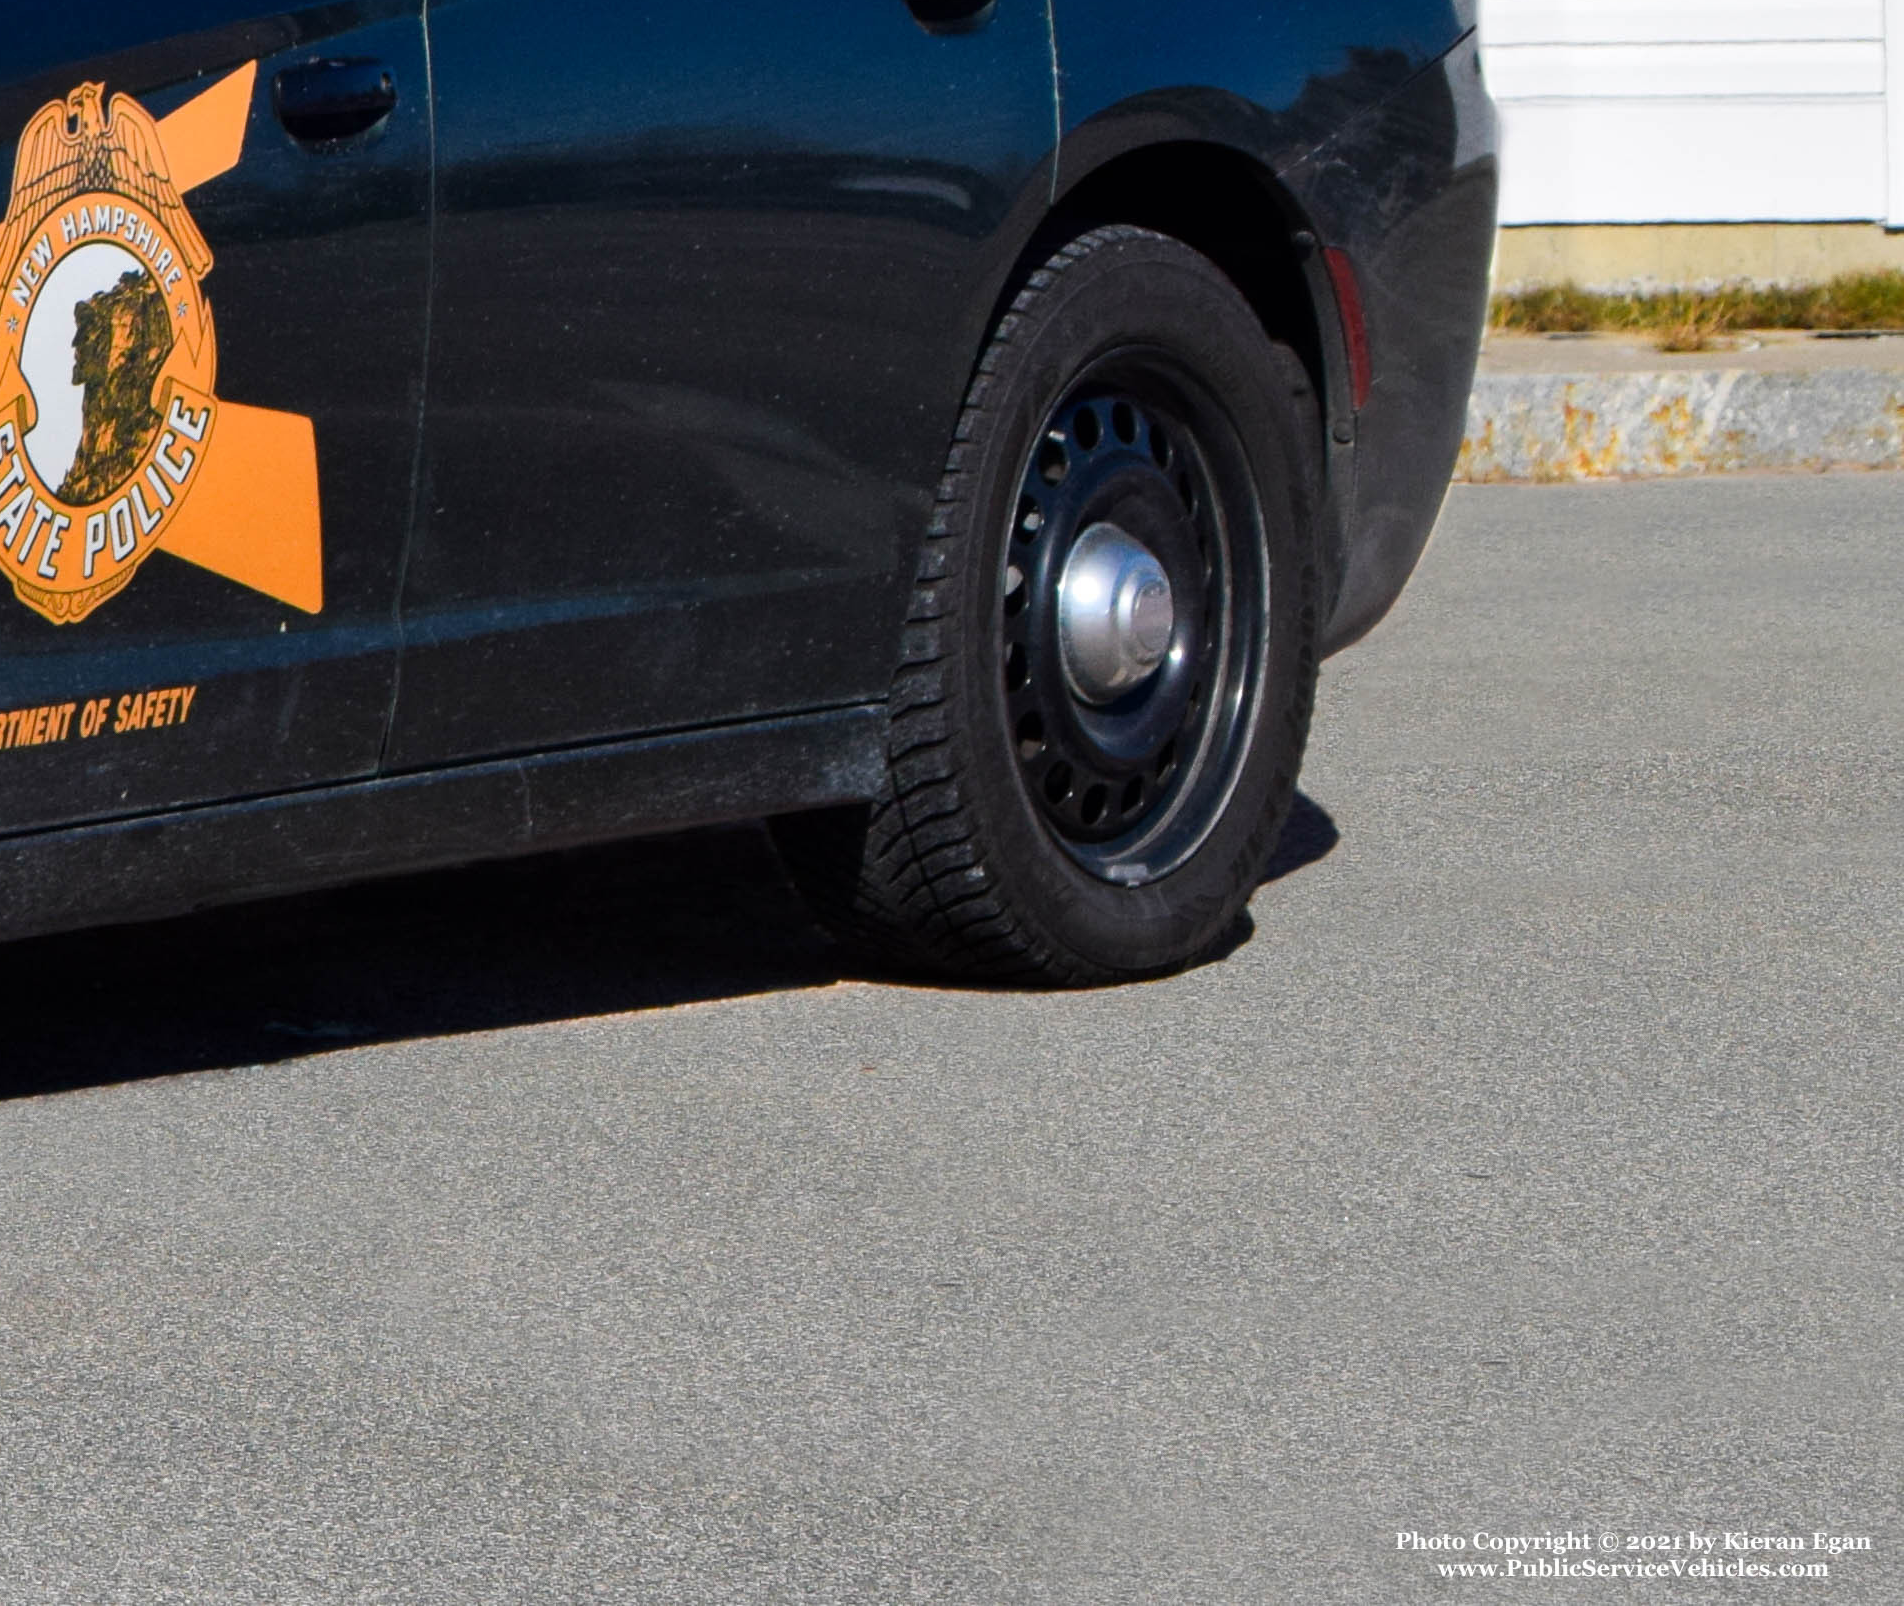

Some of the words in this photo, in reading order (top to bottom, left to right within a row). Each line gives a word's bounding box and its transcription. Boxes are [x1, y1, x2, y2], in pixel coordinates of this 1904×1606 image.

[12, 233, 55, 308] NEW
[60, 204, 181, 293] HAMPSHIRE
[83, 395, 213, 577] POLICE
[79, 698, 111, 733] OF
[113, 685, 197, 731] SAFETY
